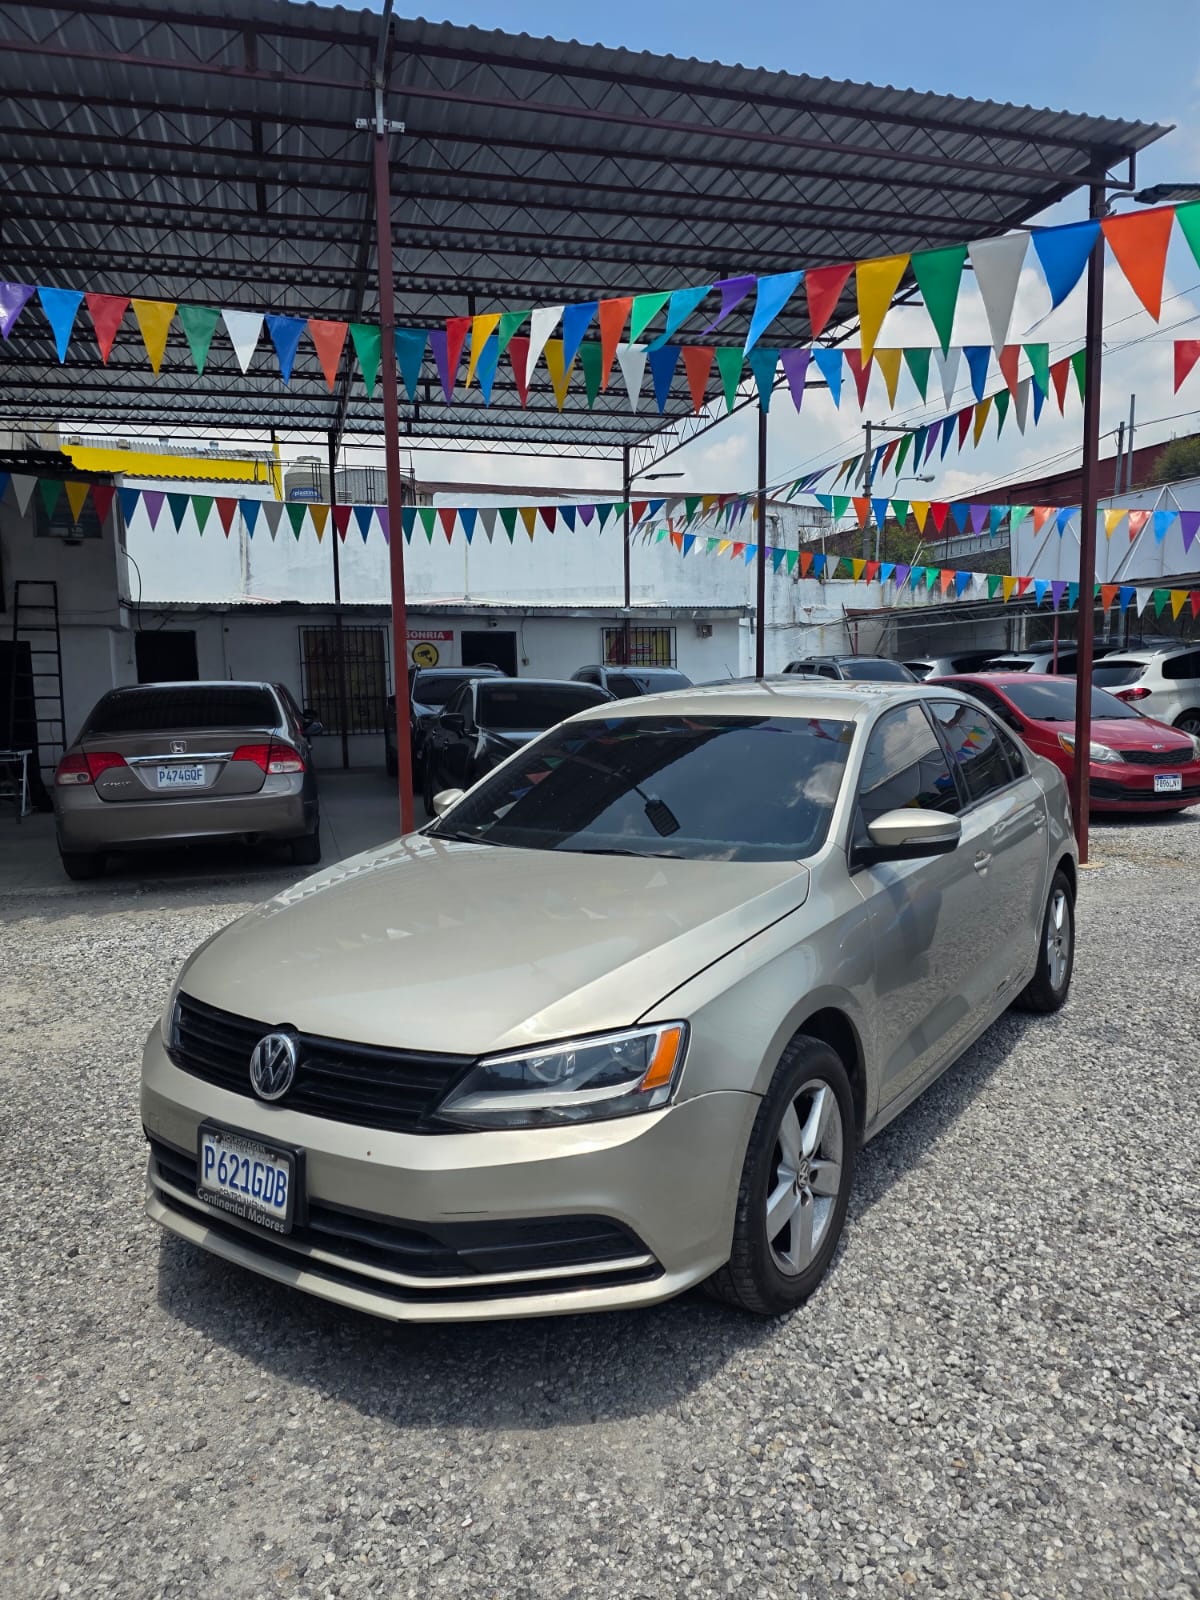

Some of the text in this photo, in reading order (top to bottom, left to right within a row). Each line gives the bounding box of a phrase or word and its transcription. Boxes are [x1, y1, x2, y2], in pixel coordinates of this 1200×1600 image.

[204, 1144, 288, 1208] P621GDB
[197, 1187, 286, 1233] Continental Motores
